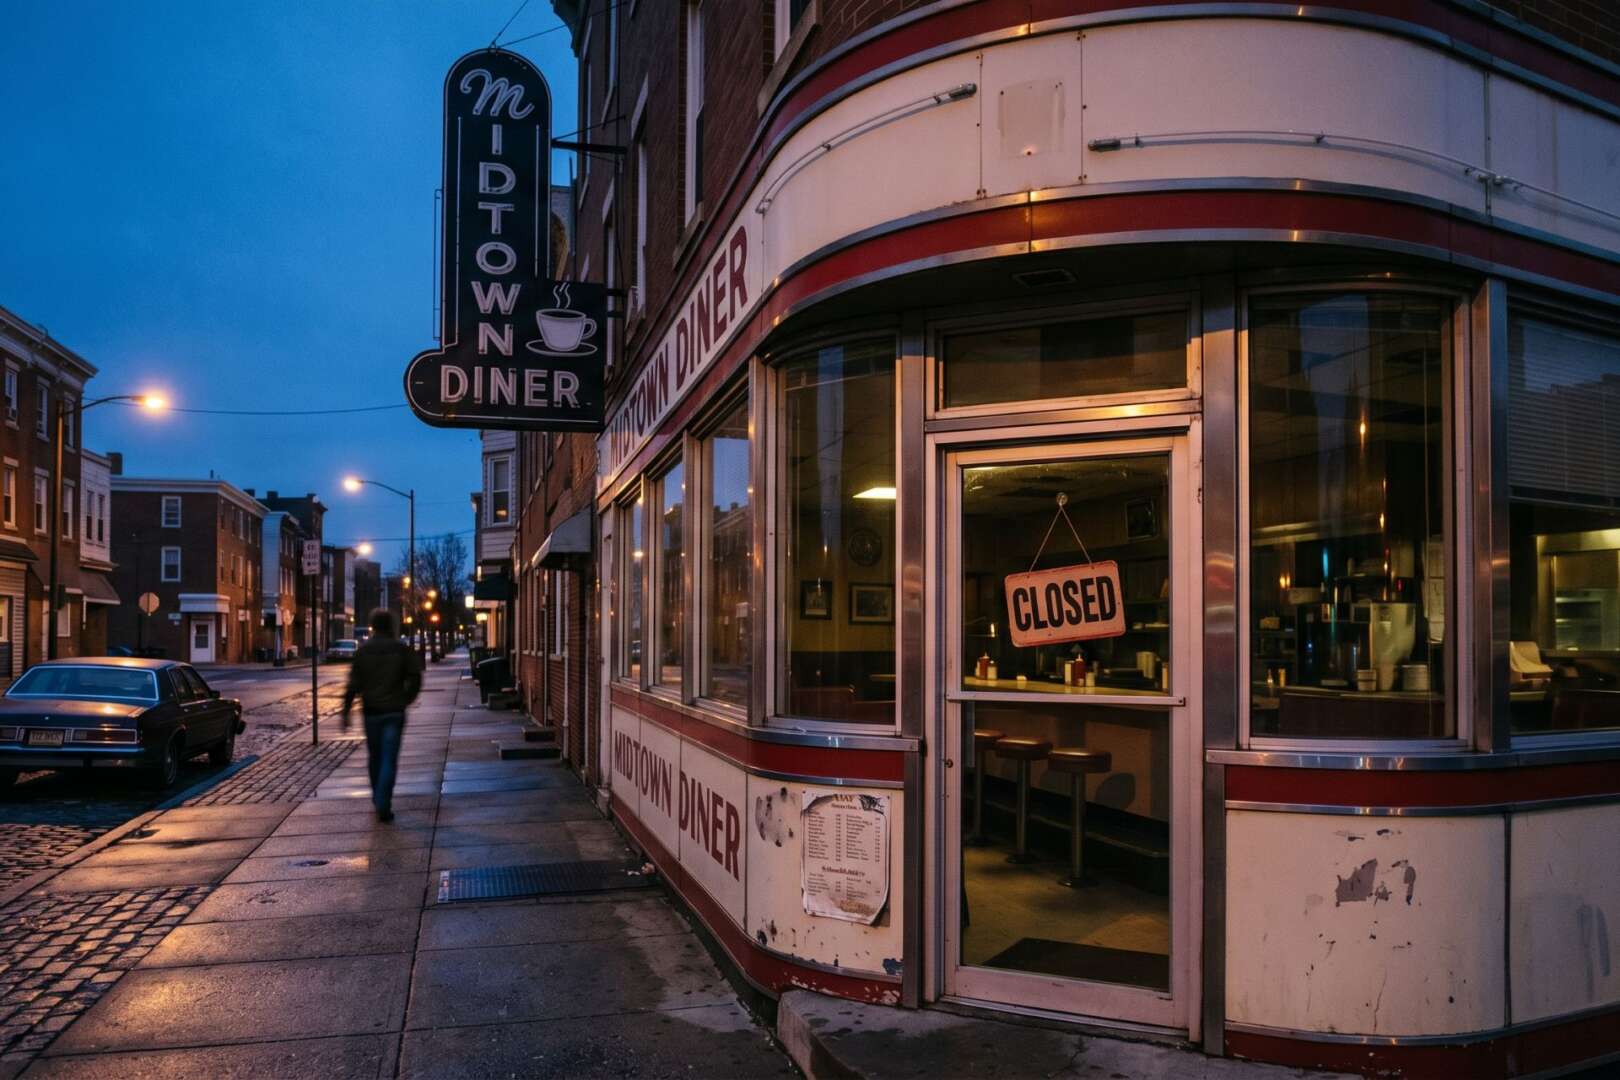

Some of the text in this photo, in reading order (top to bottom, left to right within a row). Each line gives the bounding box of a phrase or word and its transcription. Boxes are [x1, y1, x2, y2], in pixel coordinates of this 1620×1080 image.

[460, 68, 535, 356] MIDTOWN
[440, 364, 580, 408] DINER
[611, 225, 748, 474] MIDTOWN DINER
[1013, 576, 1116, 631] CLOSED
[615, 730, 672, 818] MIDTOWN
[679, 770, 740, 882] DINER
